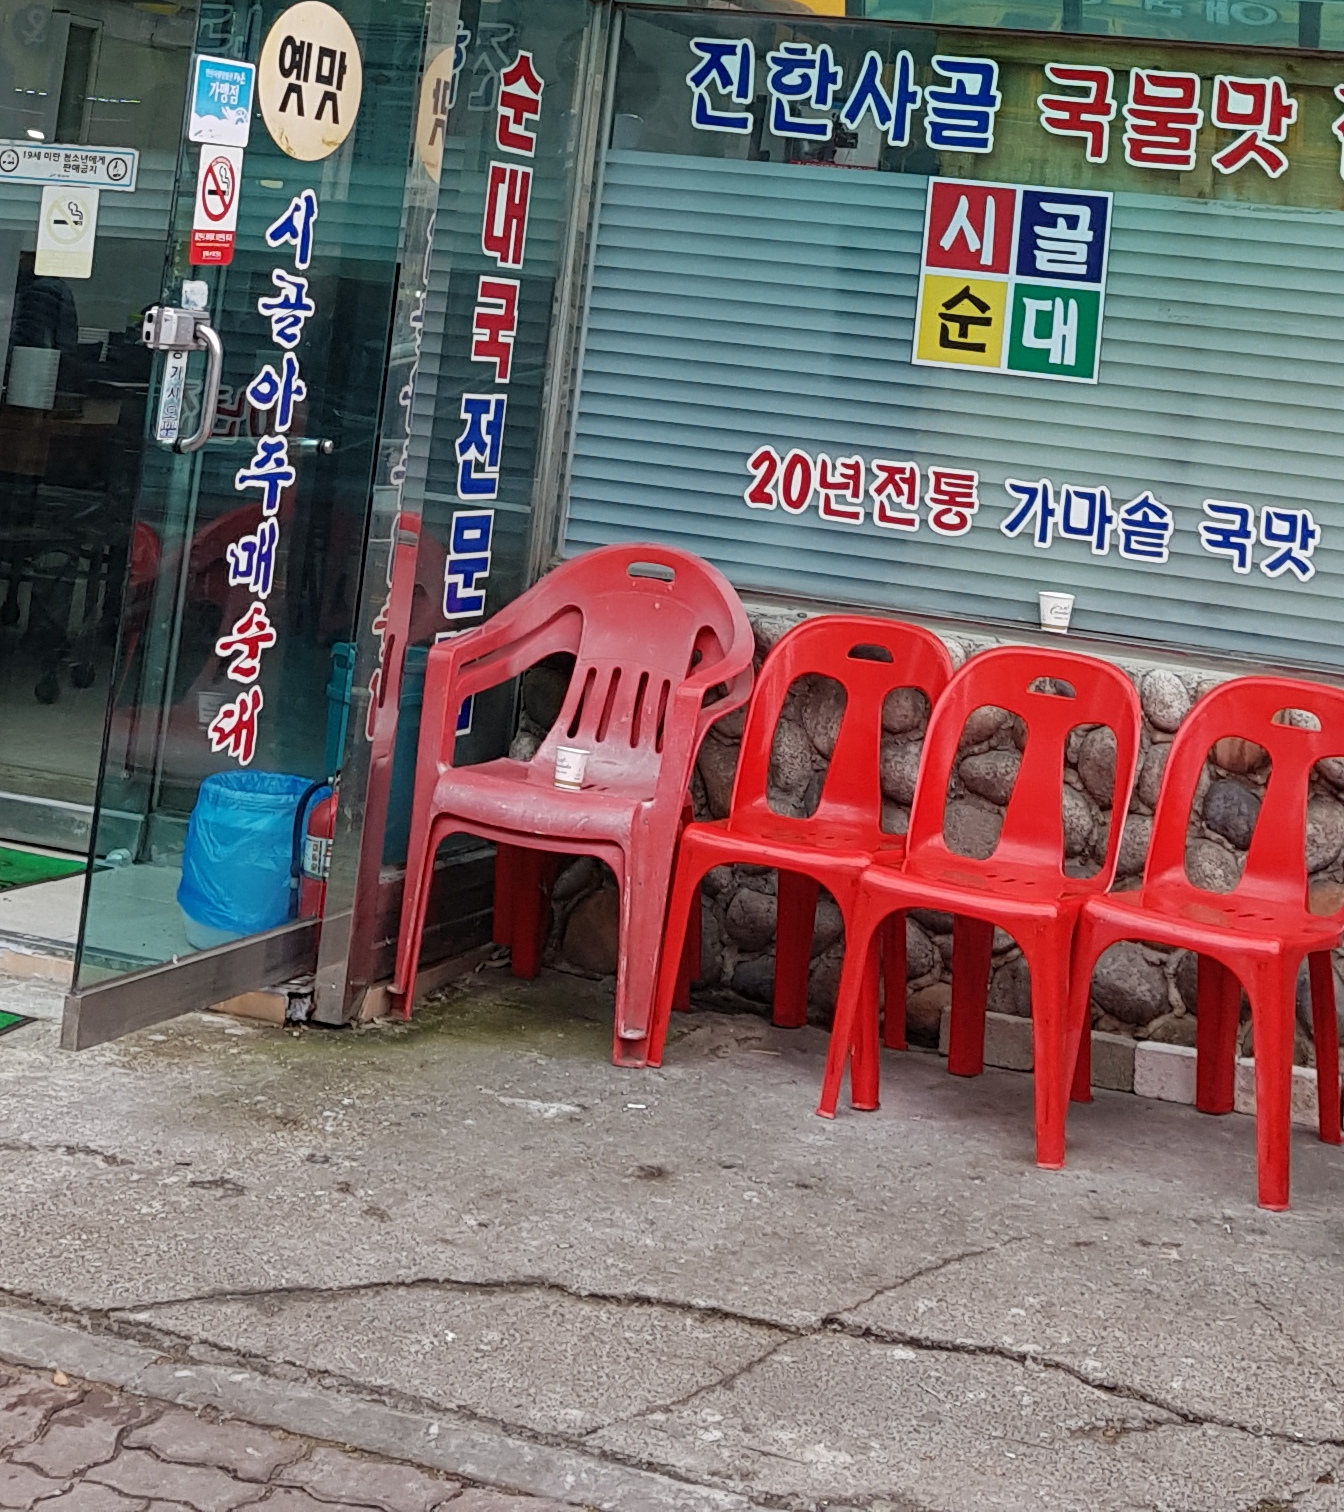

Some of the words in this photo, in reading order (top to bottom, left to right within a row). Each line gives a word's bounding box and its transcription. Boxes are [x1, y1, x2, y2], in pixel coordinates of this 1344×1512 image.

[208, 81, 240, 105] 가맹점
[278, 34, 347, 125] 옛맛
[686, 35, 1002, 156] 진한사골
[1038, 60, 1298, 180] 국물맛
[22, 150, 42, 162] 19세
[62, 163, 98, 175] 판매금지
[938, 192, 1095, 277] 시골
[938, 284, 1079, 368] 순대
[435, 49, 544, 736] 순대국전문
[743, 444, 981, 538] 20년전통
[1002, 478, 1175, 566] 가마솥
[1198, 498, 1324, 584] 국맛
